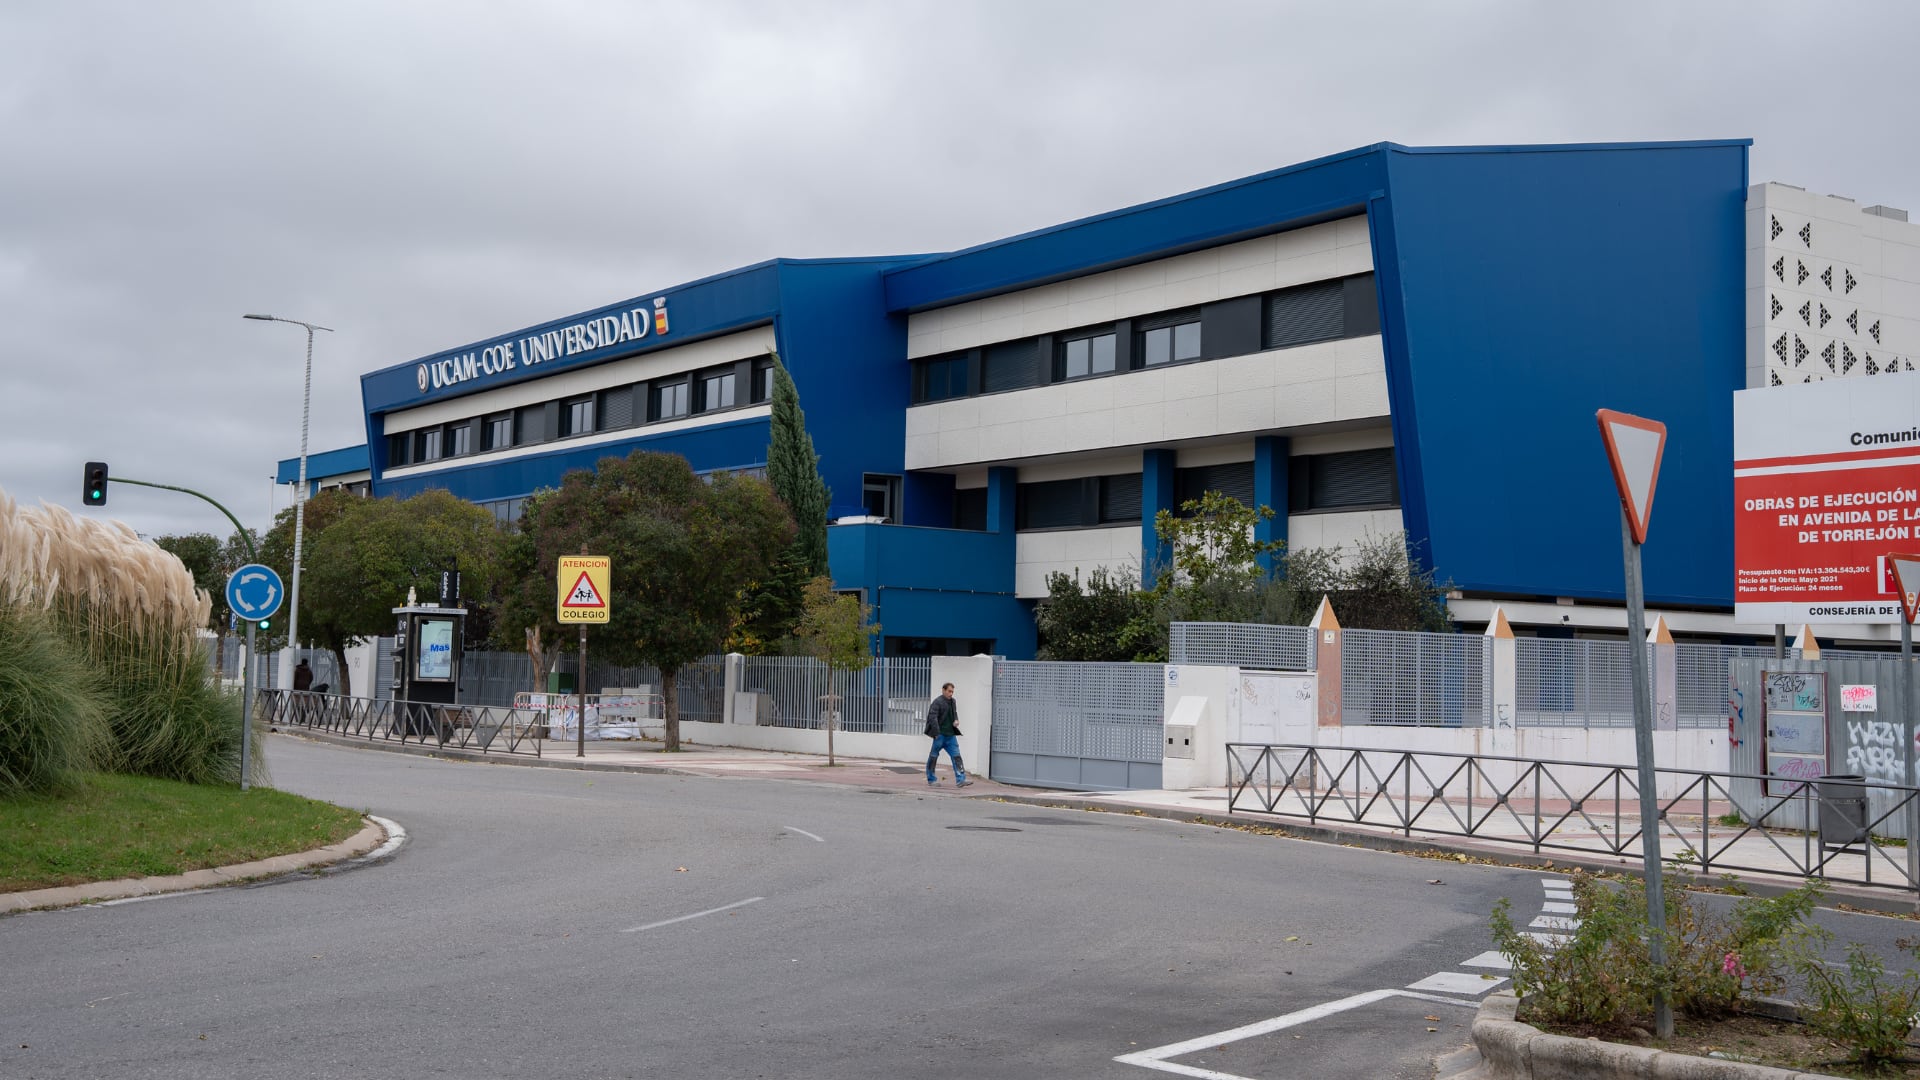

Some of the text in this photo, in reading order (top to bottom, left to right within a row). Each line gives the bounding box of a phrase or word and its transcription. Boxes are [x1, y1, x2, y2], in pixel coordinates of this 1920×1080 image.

[431, 308, 650, 388] UCAM-COE UNIVERSIDAD
[1850, 427, 1920, 445] Comuni
[1744, 487, 1917, 512] OBRAS DE EJECUCIÓN
[1778, 514, 1799, 527] EN
[1803, 510, 1872, 526] AVENIDA
[1876, 508, 1898, 522] DE
[1798, 531, 1818, 544] DE
[1822, 524, 1909, 543] TORREJÓN
[562, 560, 608, 568] ATENCION
[1738, 569, 1782, 577] Presupuesto
[1799, 575, 1819, 584] Mayo
[1738, 585, 1758, 593] Plazo
[1769, 584, 1806, 593] Ejecución:
[562, 610, 606, 619] COLEGIO
[1809, 605, 1876, 616] CONSEJERÍA
[1879, 606, 1894, 615] DE
[231, 612, 237, 628] P
